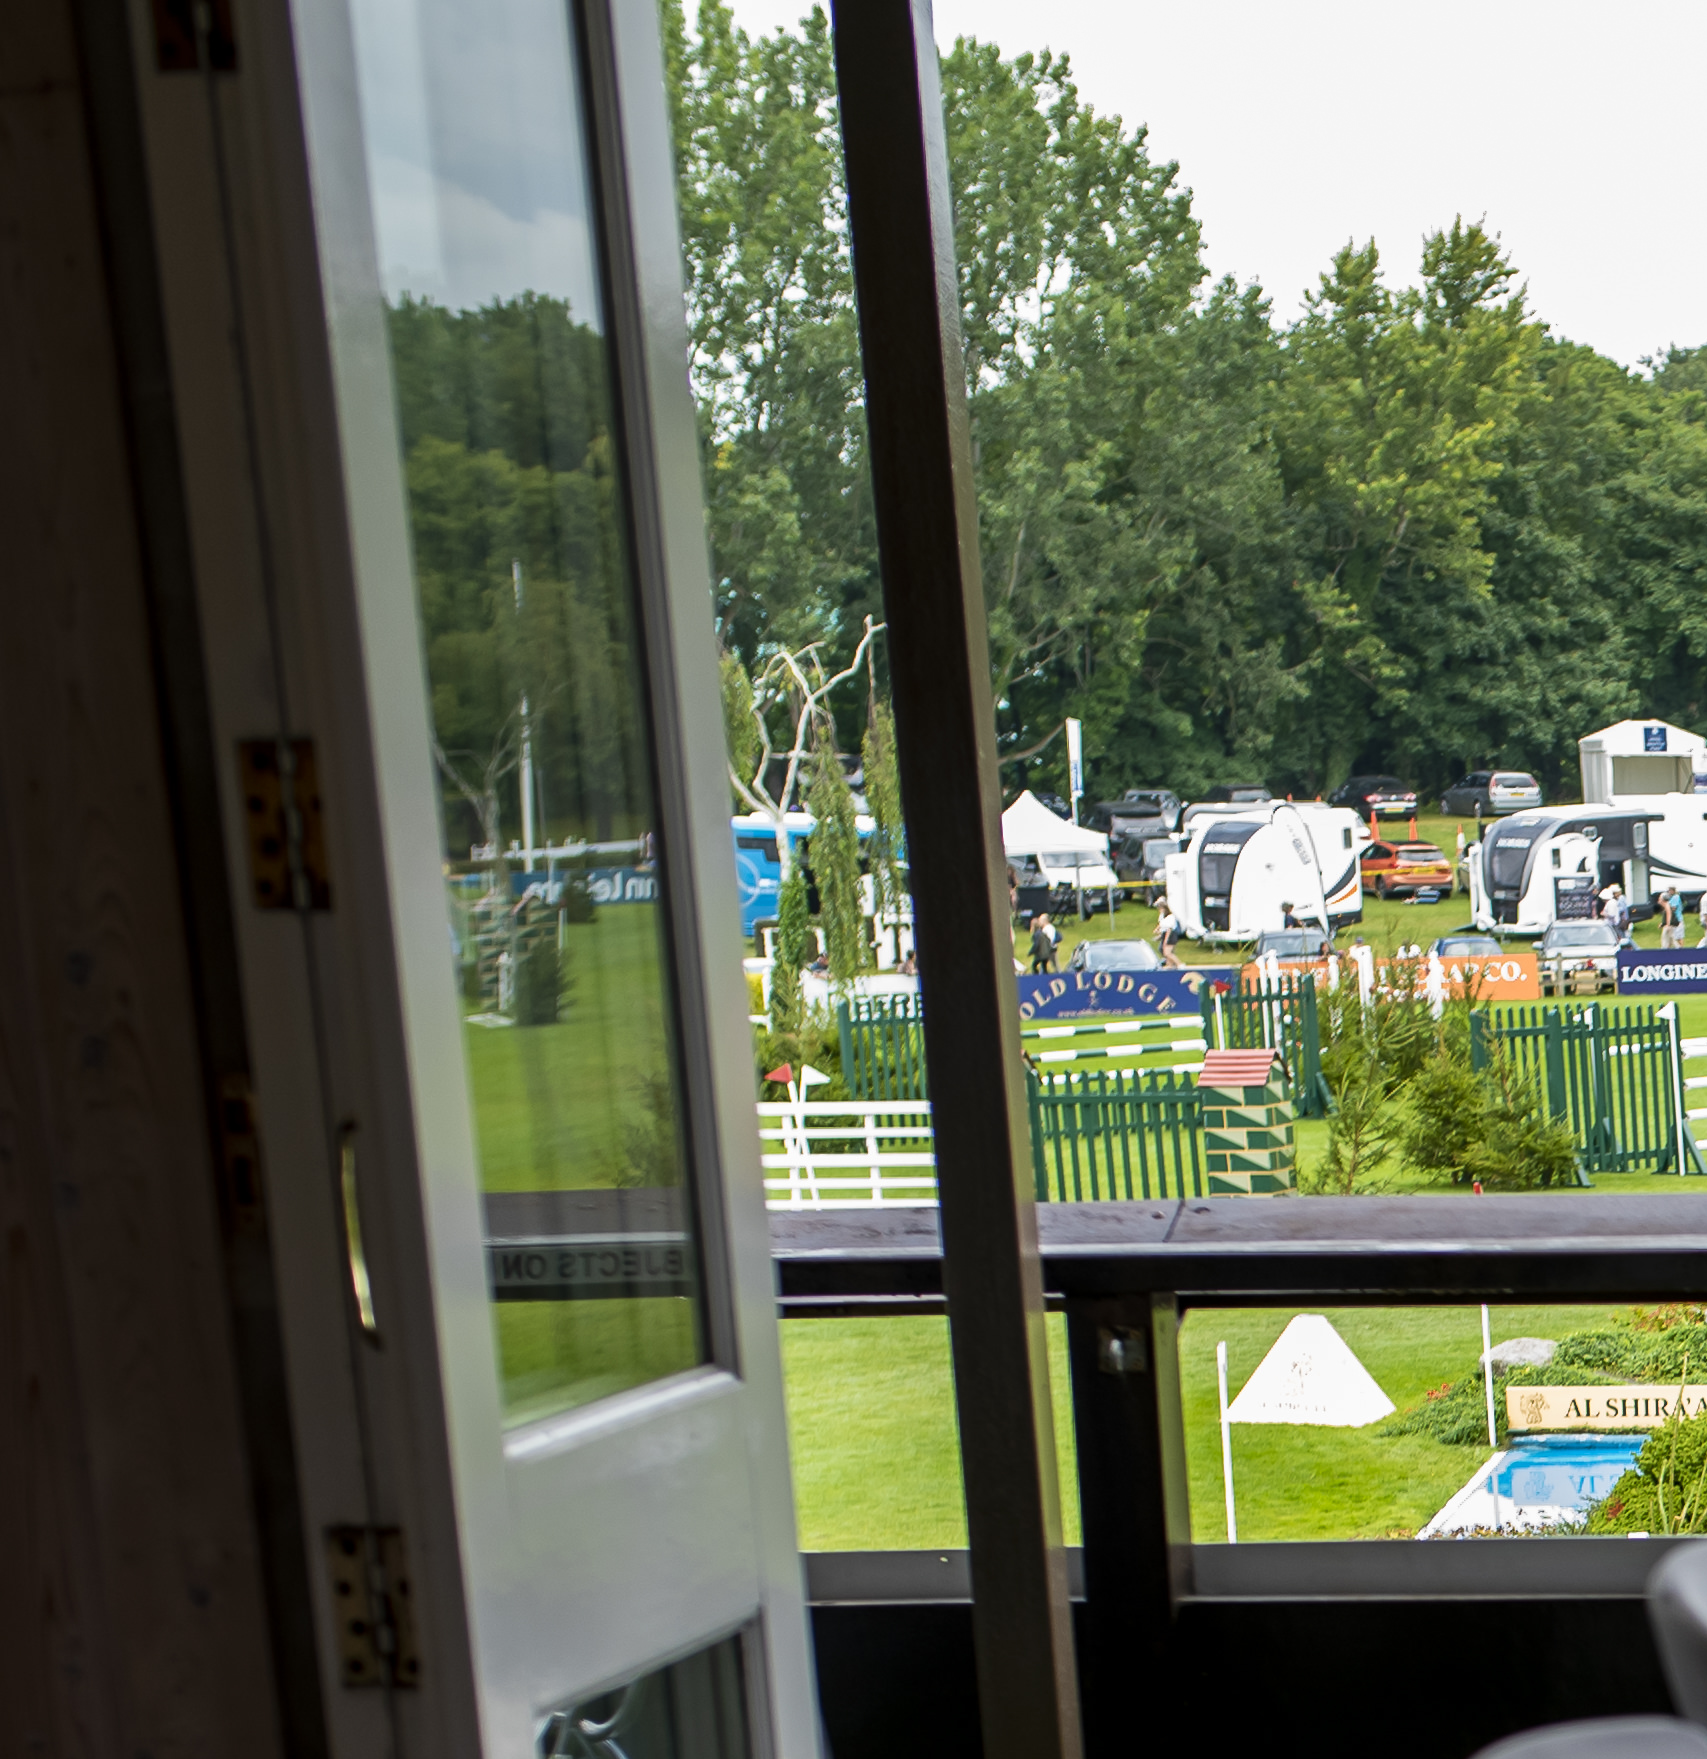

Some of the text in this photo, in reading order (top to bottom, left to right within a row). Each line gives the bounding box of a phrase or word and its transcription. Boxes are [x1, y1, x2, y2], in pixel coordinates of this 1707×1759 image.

[1018, 971, 1177, 1021] OLD LODGE
[1564, 1398, 1600, 1418] AL
